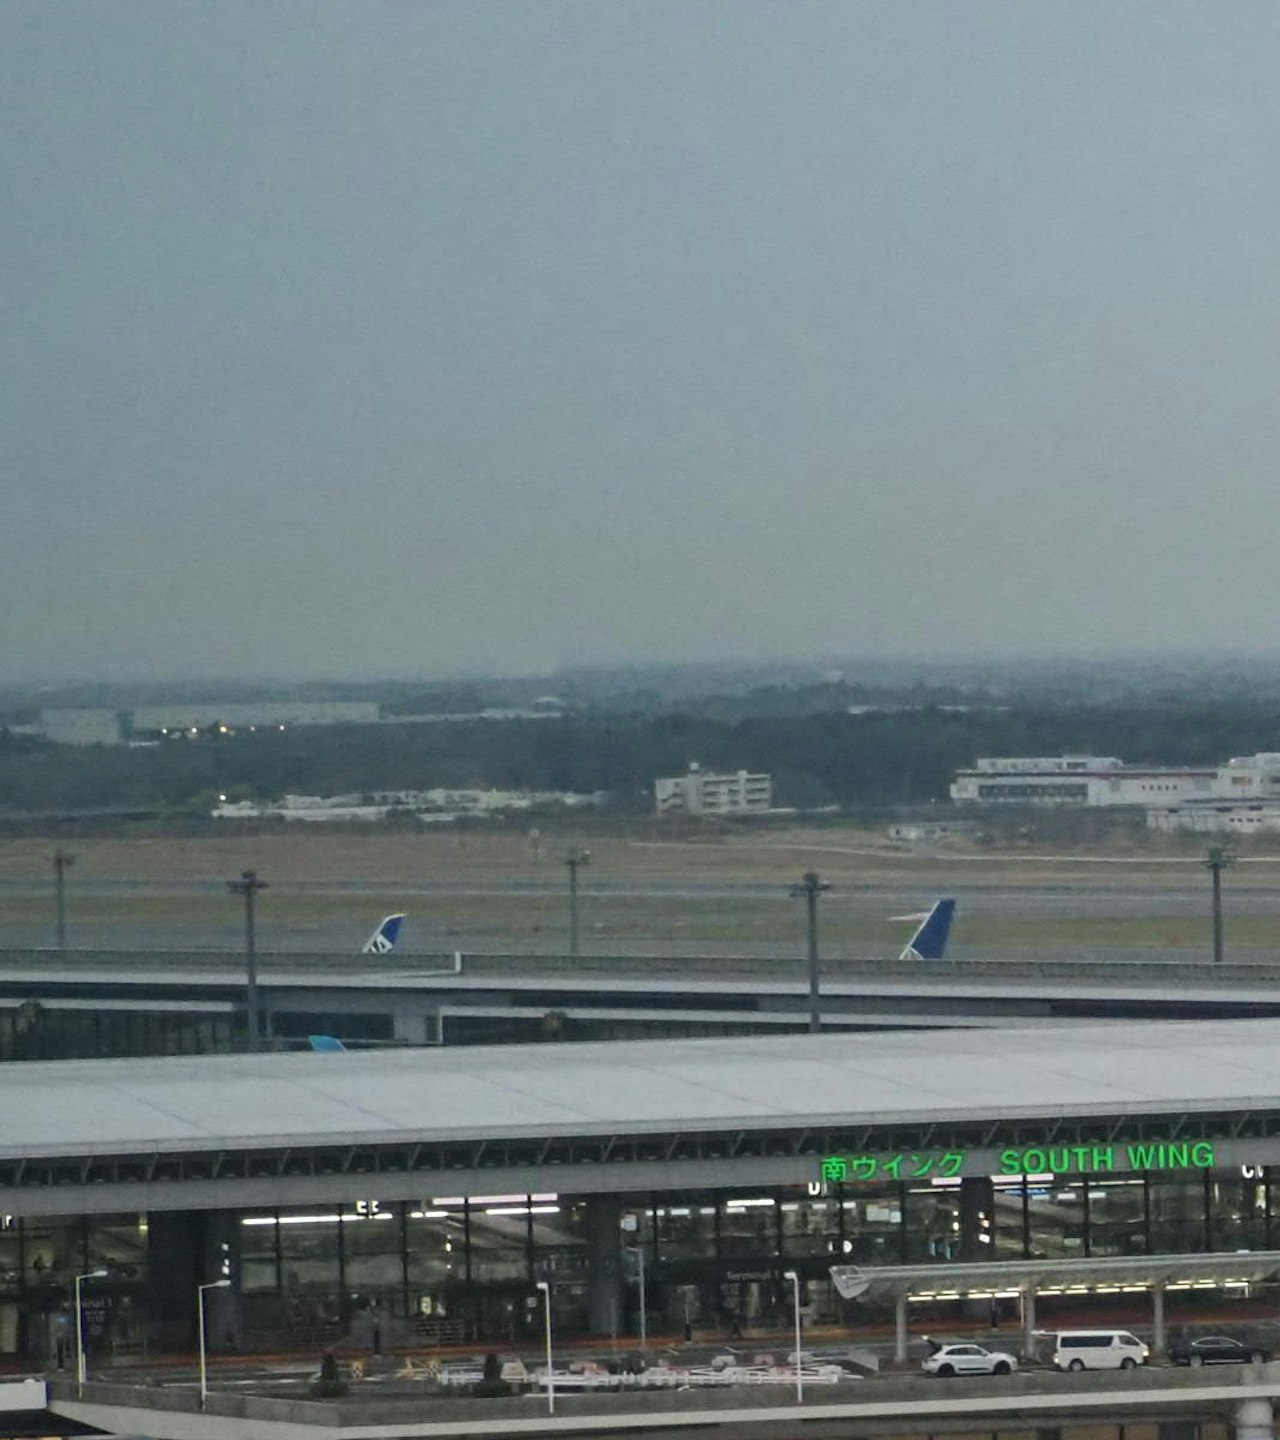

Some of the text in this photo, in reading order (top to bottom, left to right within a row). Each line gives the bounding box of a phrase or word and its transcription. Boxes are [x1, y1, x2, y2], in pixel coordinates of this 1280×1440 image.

[820, 1151, 965, 1182] 南ウイング
[1000, 1141, 1215, 1175] SOUTH WING
